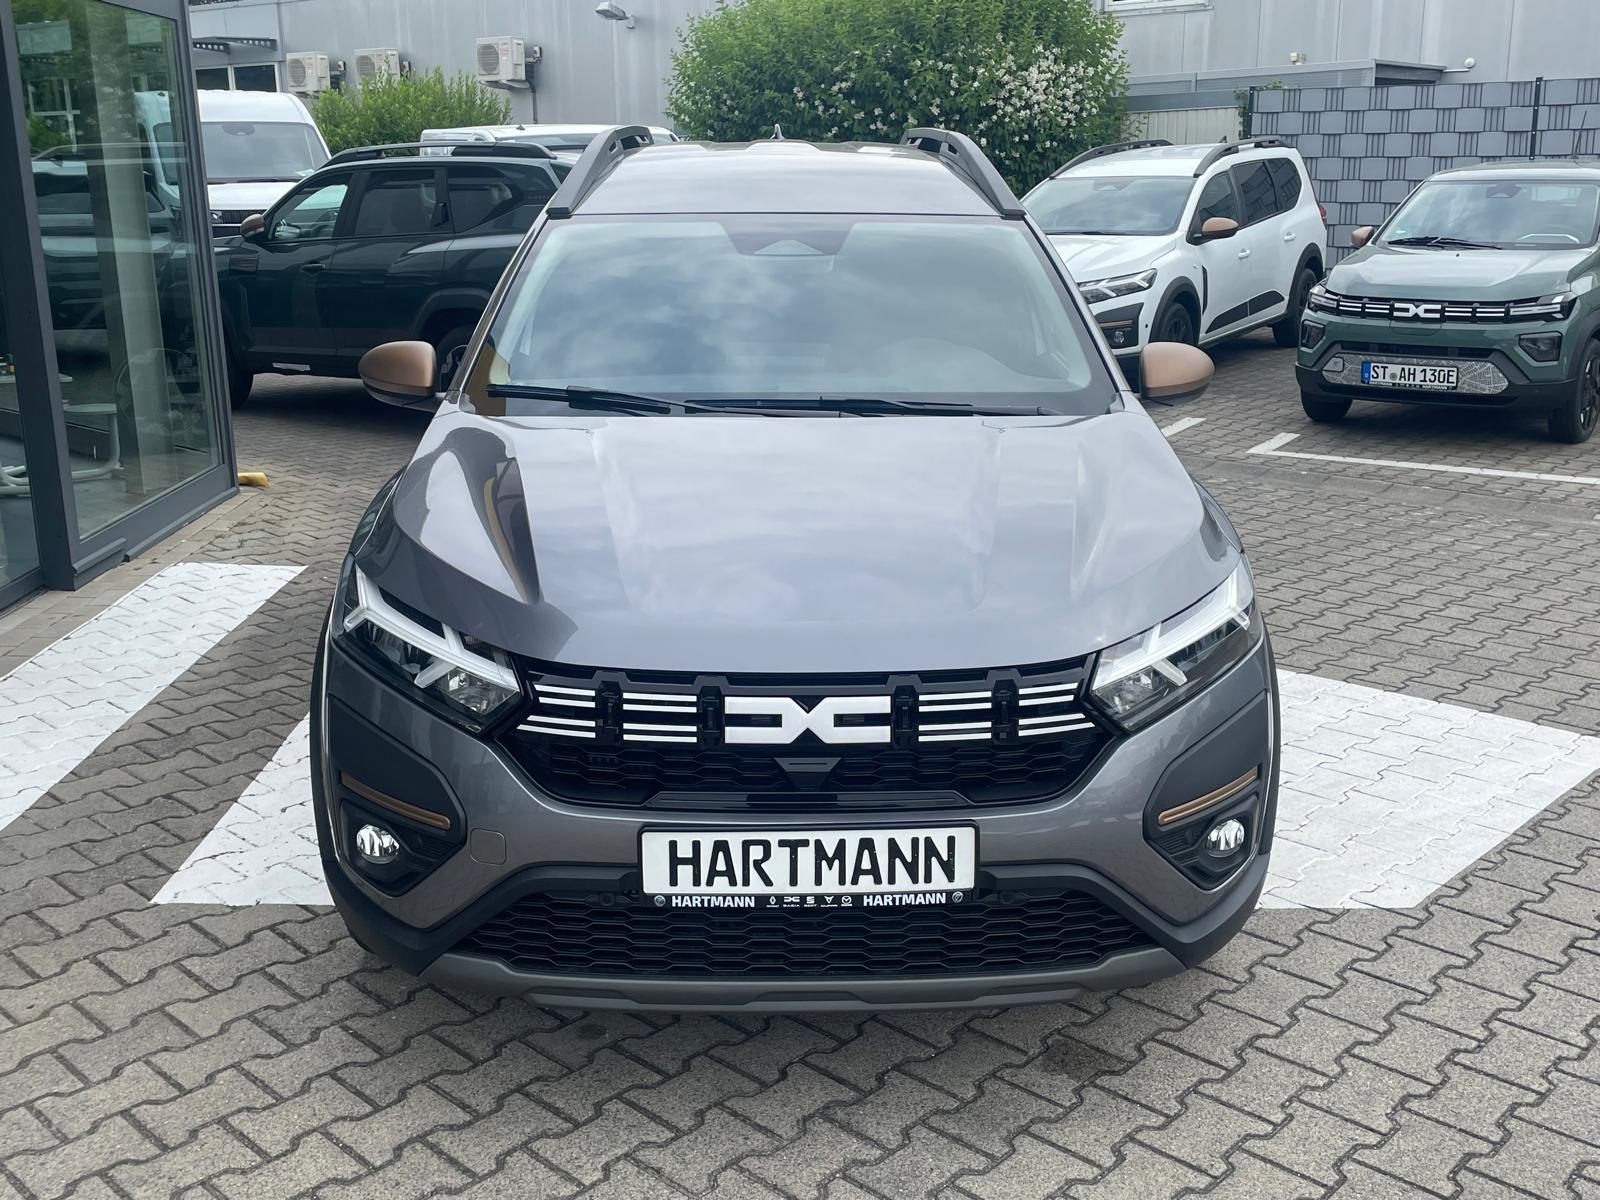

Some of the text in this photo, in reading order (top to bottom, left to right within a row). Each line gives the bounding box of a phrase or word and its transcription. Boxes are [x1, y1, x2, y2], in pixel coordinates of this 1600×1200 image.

[1371, 365, 1456, 384] ST AH 130E
[668, 836, 956, 887] HARTMANN
[671, 896, 755, 908] HARTMANN
[863, 893, 946, 907] HARTMANN
